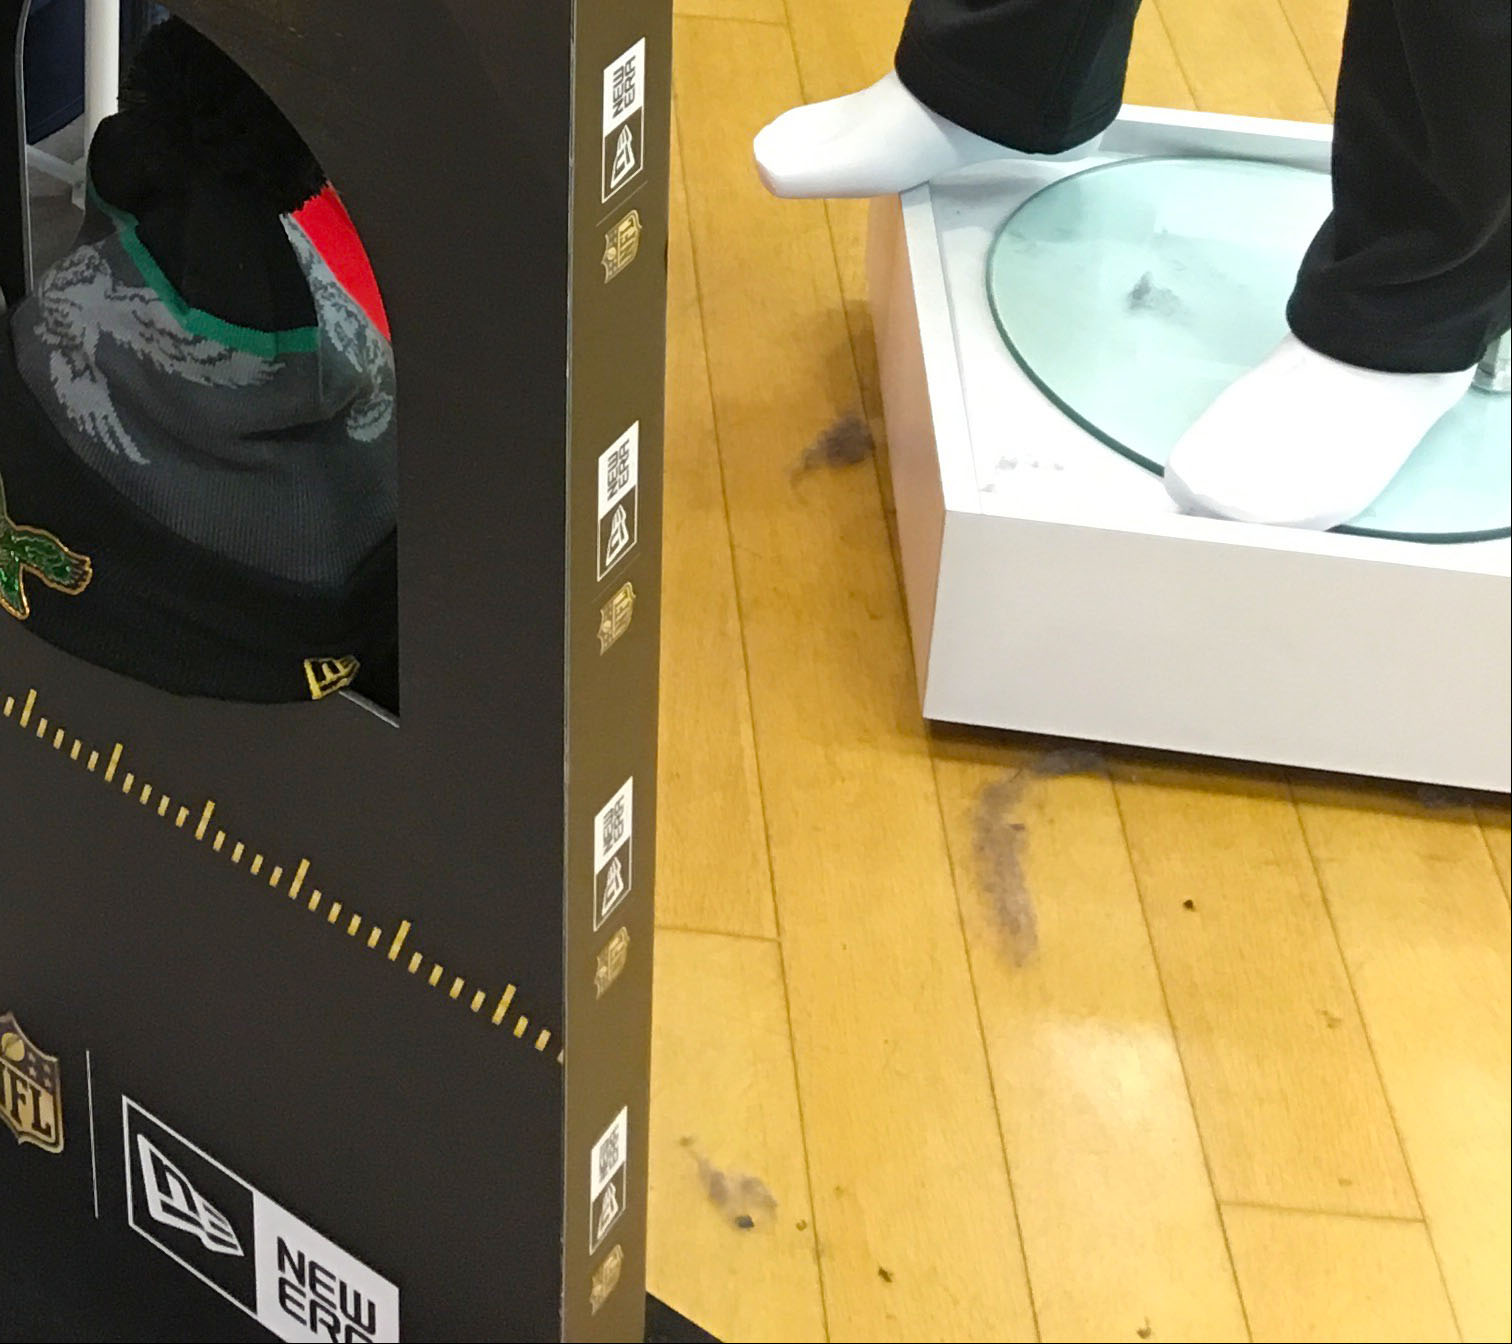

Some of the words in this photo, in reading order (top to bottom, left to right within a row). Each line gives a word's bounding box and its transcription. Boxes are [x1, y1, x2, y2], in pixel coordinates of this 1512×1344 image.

[612, 66, 625, 119] NEW
[624, 55, 637, 108] ERA
[276, 1235, 376, 1336] NEW
